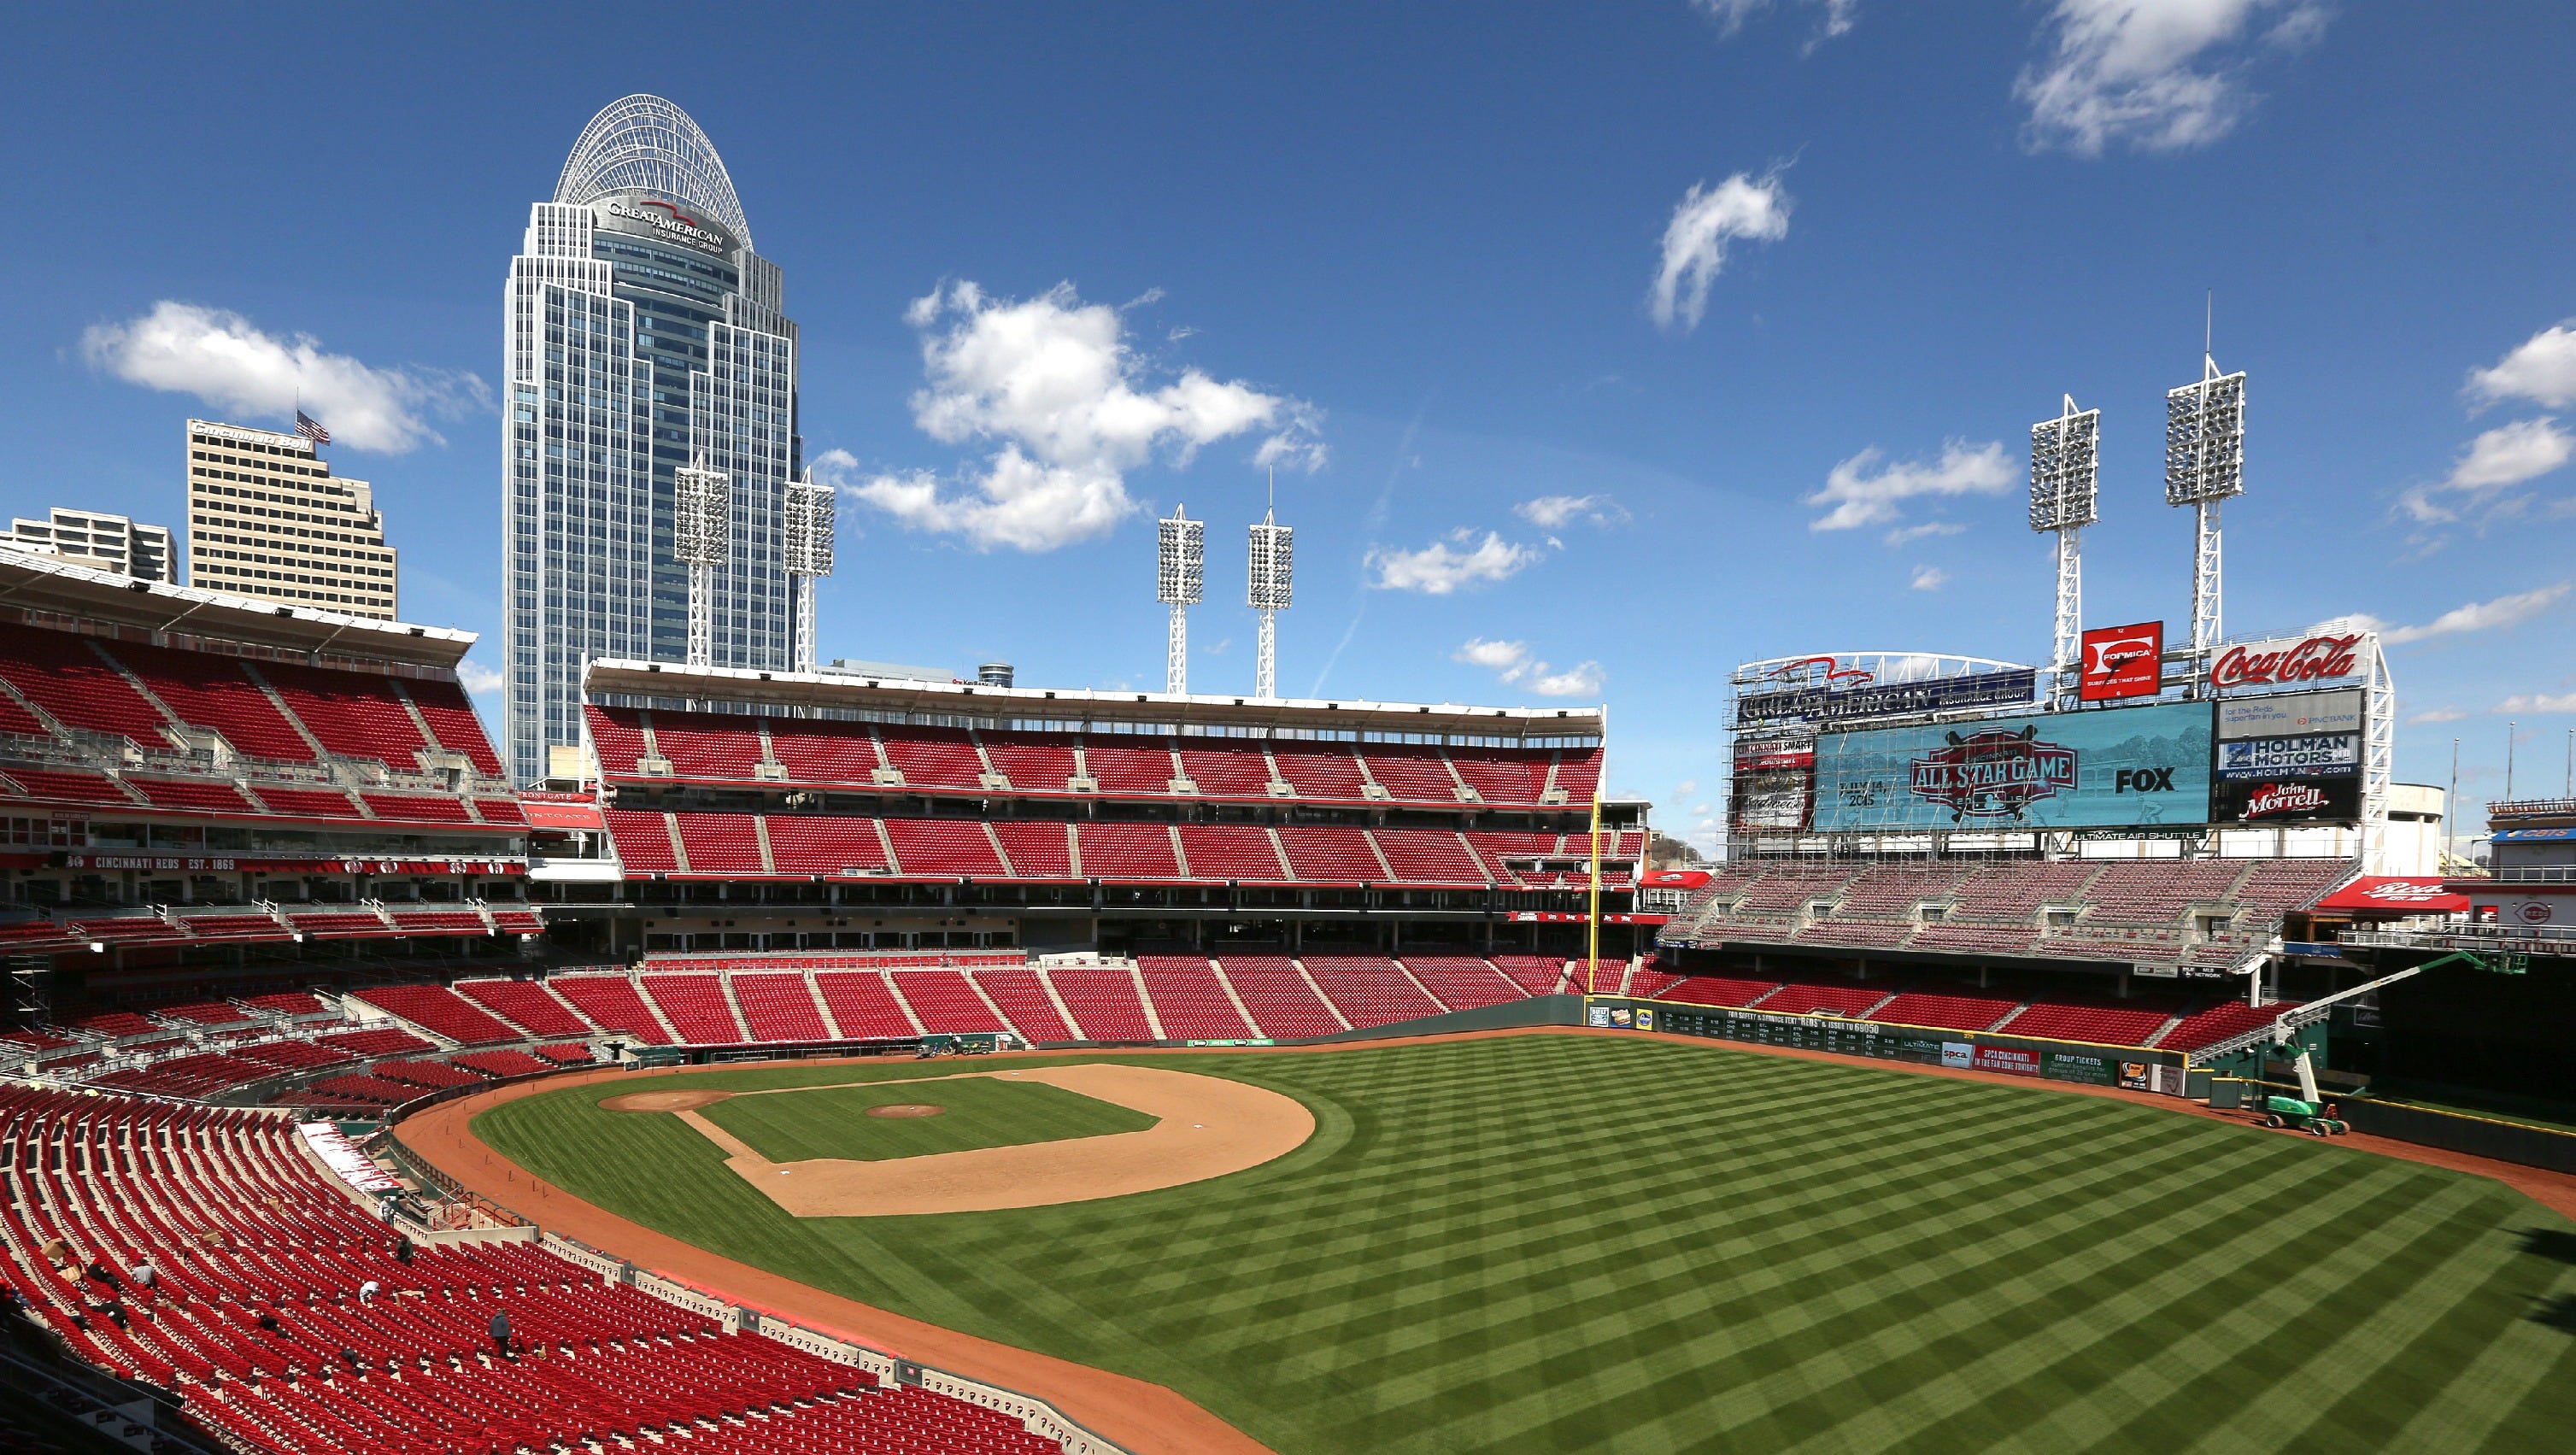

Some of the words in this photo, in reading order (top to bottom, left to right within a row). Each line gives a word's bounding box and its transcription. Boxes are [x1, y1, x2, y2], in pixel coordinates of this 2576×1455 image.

[607, 202, 660, 222] GREAT
[653, 215, 724, 245] AMERICAN
[653, 228, 696, 247] INSURANCE
[699, 240, 723, 254] GROUP
[2211, 632, 2365, 687] Coca-Cola
[2252, 705, 2274, 713] Reds
[2330, 714, 2357, 723] BANK
[1783, 740, 1811, 751] SMART
[2256, 736, 2348, 753] HOLMAN
[1916, 766, 1952, 788] ALL
[1957, 761, 2007, 788] STAR
[2011, 755, 2070, 781] GAME
[2115, 767, 2176, 794] FOX
[2272, 783, 2307, 798] John
[1849, 794, 1875, 807] 2015
[2239, 788, 2330, 818] Morrell
[2074, 831, 2127, 841] ULTIMATE
[2149, 831, 2201, 840] SHUTTLE
[96, 857, 152, 870] CINCINNATI
[155, 858, 179, 870] REDS
[188, 859, 209, 870] EST.
[213, 859, 235, 871] 1869
[1739, 1012, 1757, 1020] SAFETY
[1762, 1014, 1784, 1024] SERVICE
[1828, 1021, 1845, 1030] ISSUE
[1854, 1023, 1880, 1035] 69050
[1904, 1041, 1940, 1050] ULTIMATE
[1944, 1049, 1968, 1059] spca
[1984, 1049, 1998, 1059] SPCA
[1998, 1051, 2029, 1062] CINCINNATI
[2055, 1053, 2074, 1062] GROUP
[2076, 1056, 2102, 1065] TICKETS
[2001, 1061, 2014, 1070] ZONE
